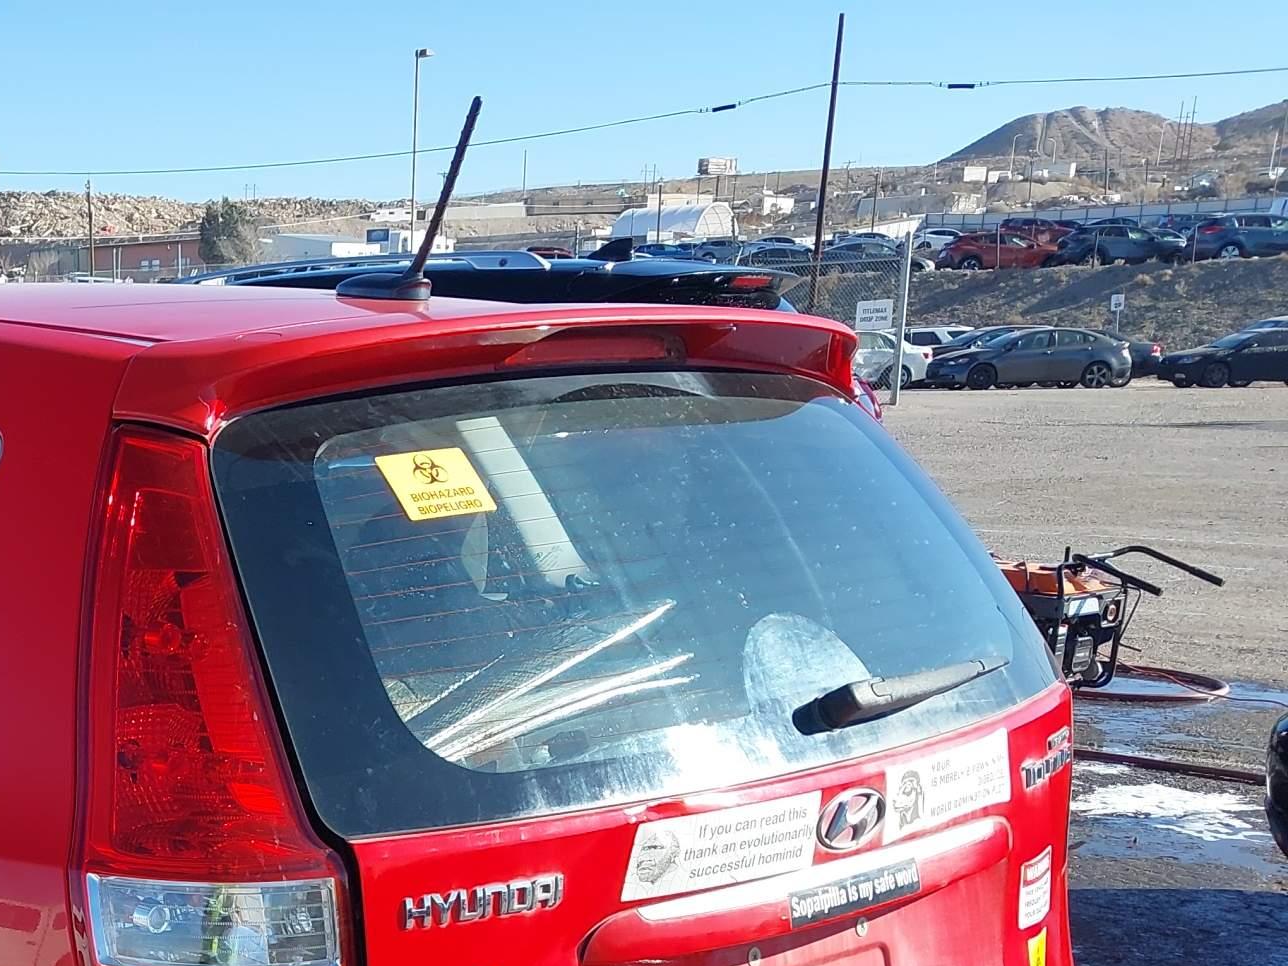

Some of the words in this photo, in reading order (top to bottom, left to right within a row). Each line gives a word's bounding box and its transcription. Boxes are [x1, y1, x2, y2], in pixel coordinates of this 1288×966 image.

[410, 486, 475, 502] BIOHAZARD
[417, 499, 483, 515] BIOPELIGRO
[698, 824, 708, 839] If
[710, 822, 732, 841] you
[735, 819, 757, 834] can
[760, 810, 786, 828] read
[788, 806, 808, 823] this
[683, 842, 718, 862] thank
[721, 840, 737, 855] an
[739, 824, 815, 851] evolutionarily
[688, 854, 756, 880] successful
[757, 844, 804, 866] hominid
[847, 880, 859, 902] is
[858, 880, 874, 901] my
[874, 869, 896, 895] safe
[894, 861, 919, 889] word
[403, 873, 566, 930] HYUNDAI
